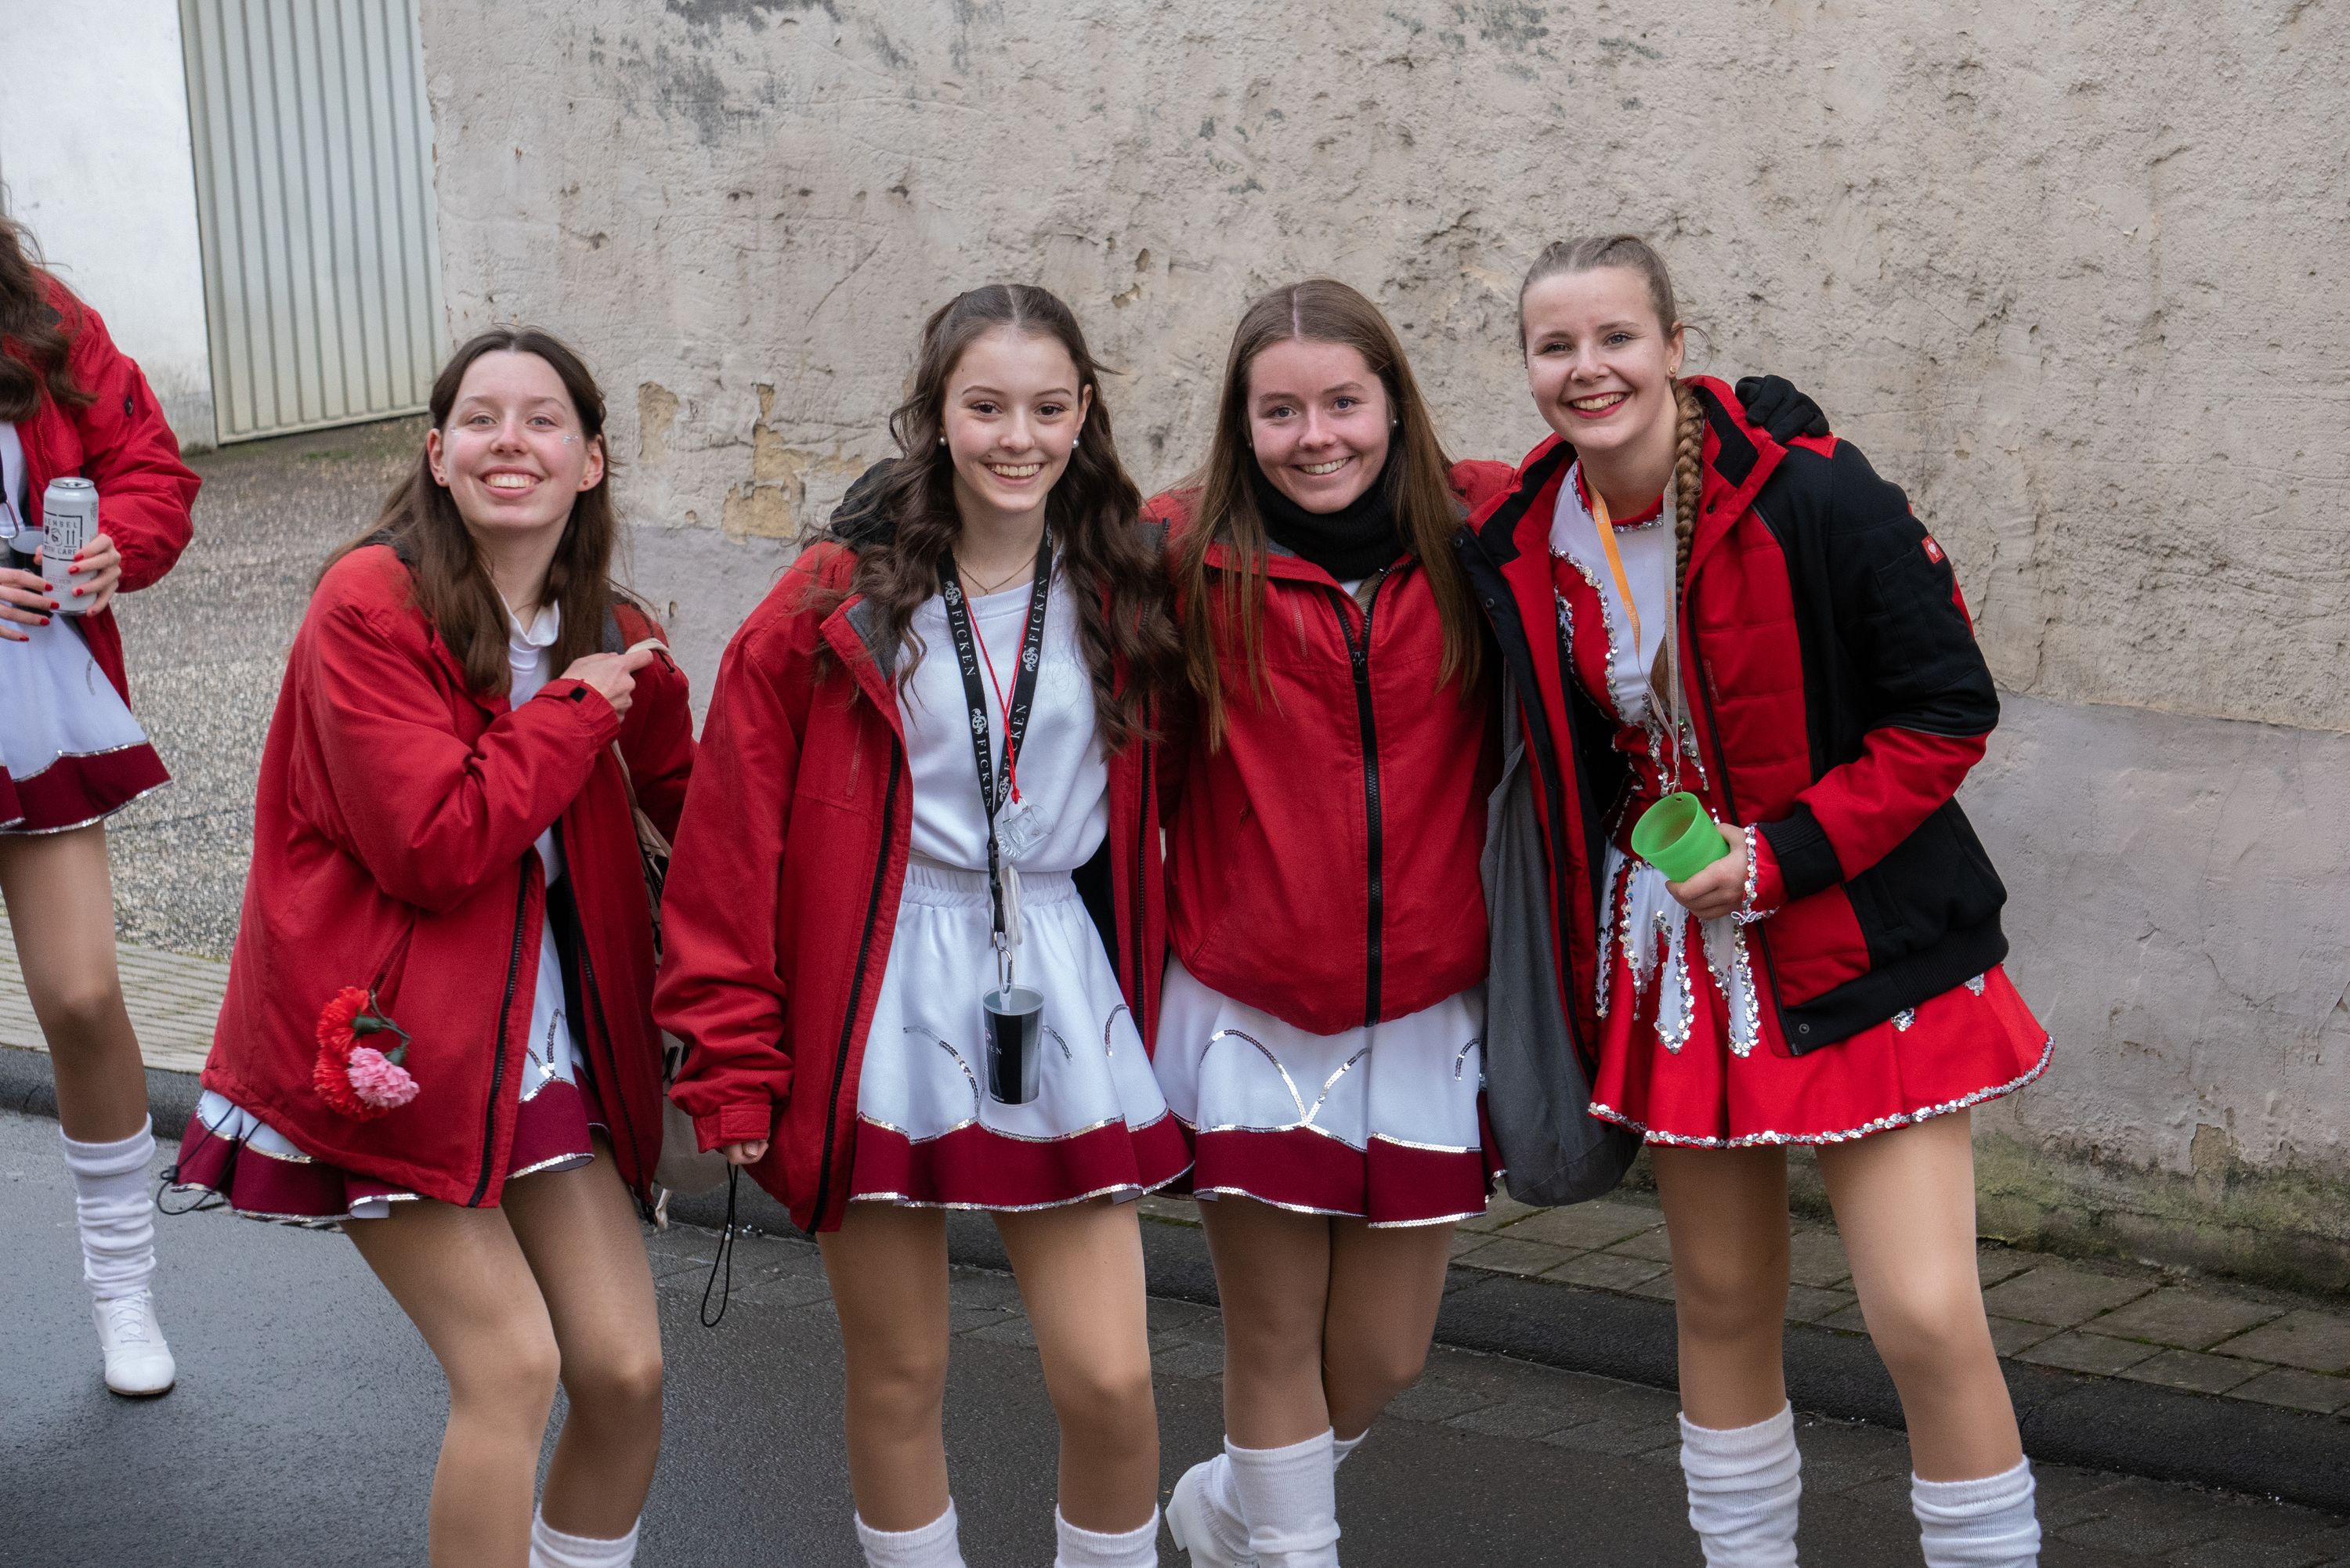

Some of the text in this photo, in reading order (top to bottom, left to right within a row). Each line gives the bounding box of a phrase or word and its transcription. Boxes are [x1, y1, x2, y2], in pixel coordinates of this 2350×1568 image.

[952, 609, 976, 676] FICKEN
[1029, 576, 1047, 642] FICKEN
[1004, 703, 1027, 771] FKEN
[977, 739, 992, 807] FICKEN
